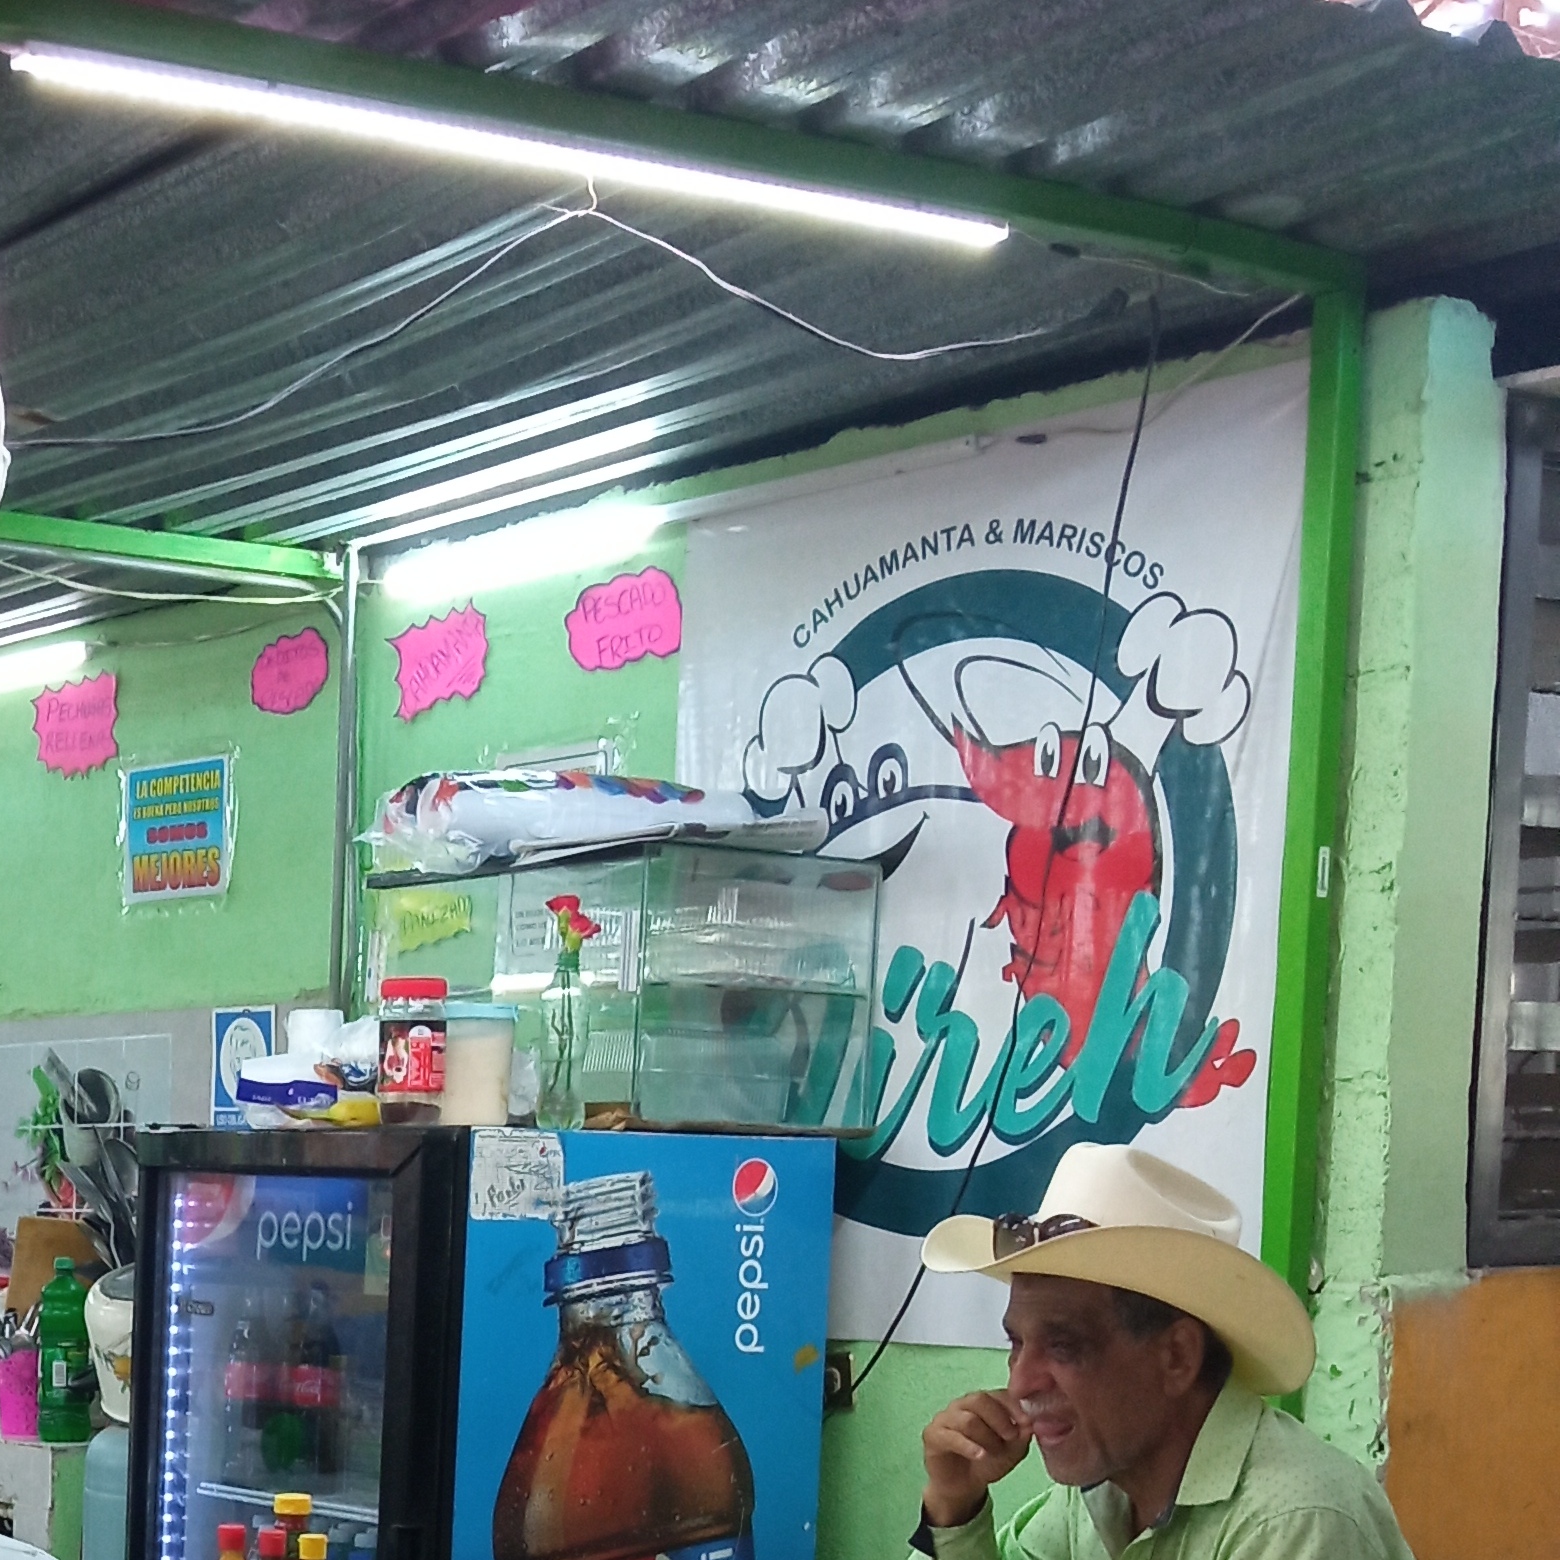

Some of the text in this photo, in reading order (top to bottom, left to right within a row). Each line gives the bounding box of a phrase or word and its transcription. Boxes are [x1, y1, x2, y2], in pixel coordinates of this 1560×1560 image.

[580, 582, 666, 624] PESCADO
[792, 518, 1164, 649] CAHUAMANTA & MARISCOS
[596, 624, 663, 664] FRITO
[136, 769, 221, 799] LA COMPETENCIA
[147, 821, 208, 844] SOMOS
[132, 846, 221, 893] MEJORES
[256, 1201, 352, 1261] pepsi
[734, 1222, 769, 1353] pepsi
